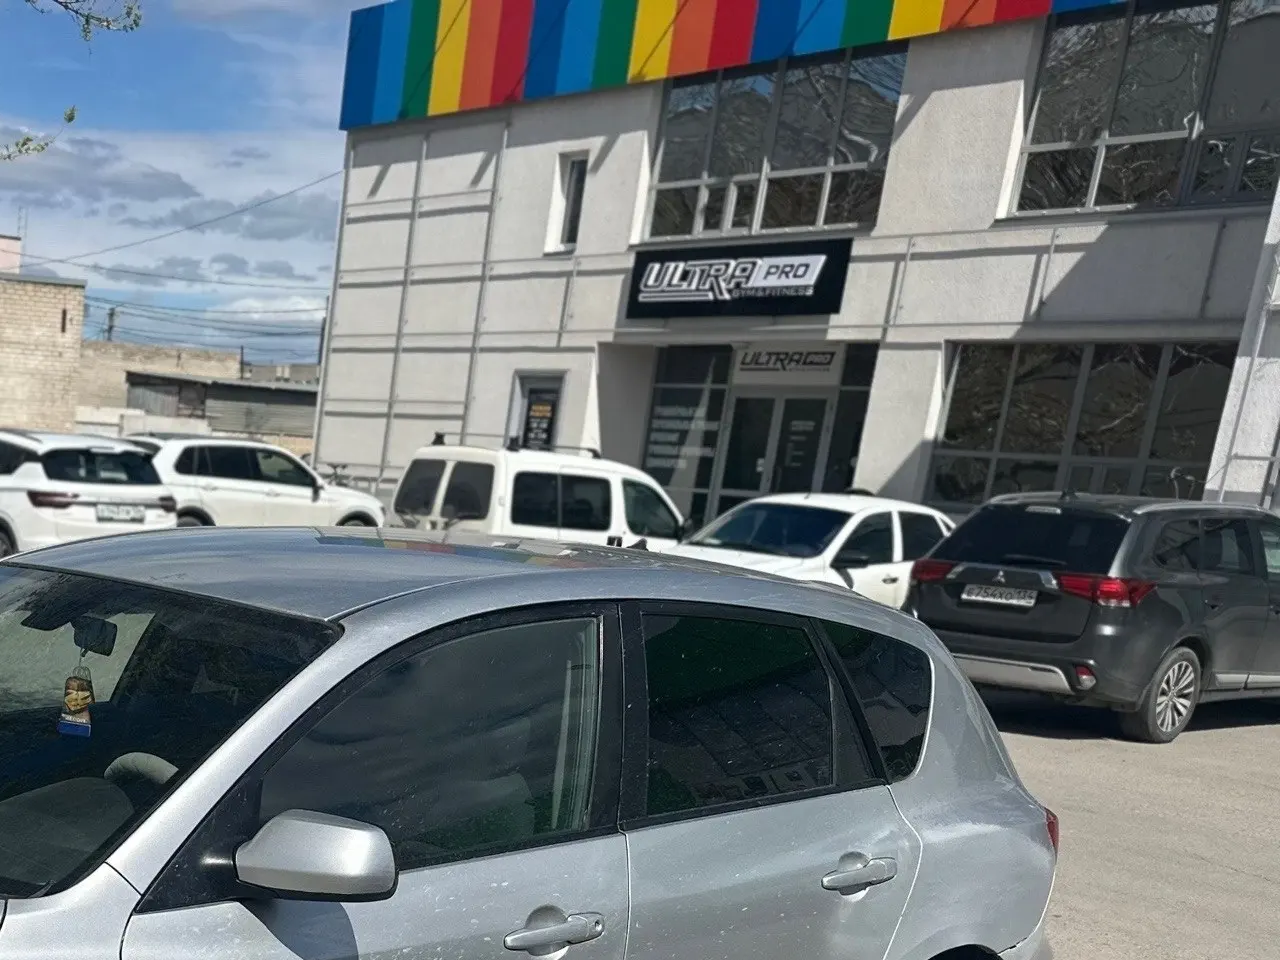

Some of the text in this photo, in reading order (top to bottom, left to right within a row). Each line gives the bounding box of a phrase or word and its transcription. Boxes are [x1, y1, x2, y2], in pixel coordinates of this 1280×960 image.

[640, 258, 810, 300] ULTRA PRO
[740, 351, 802, 372] ULTRA
